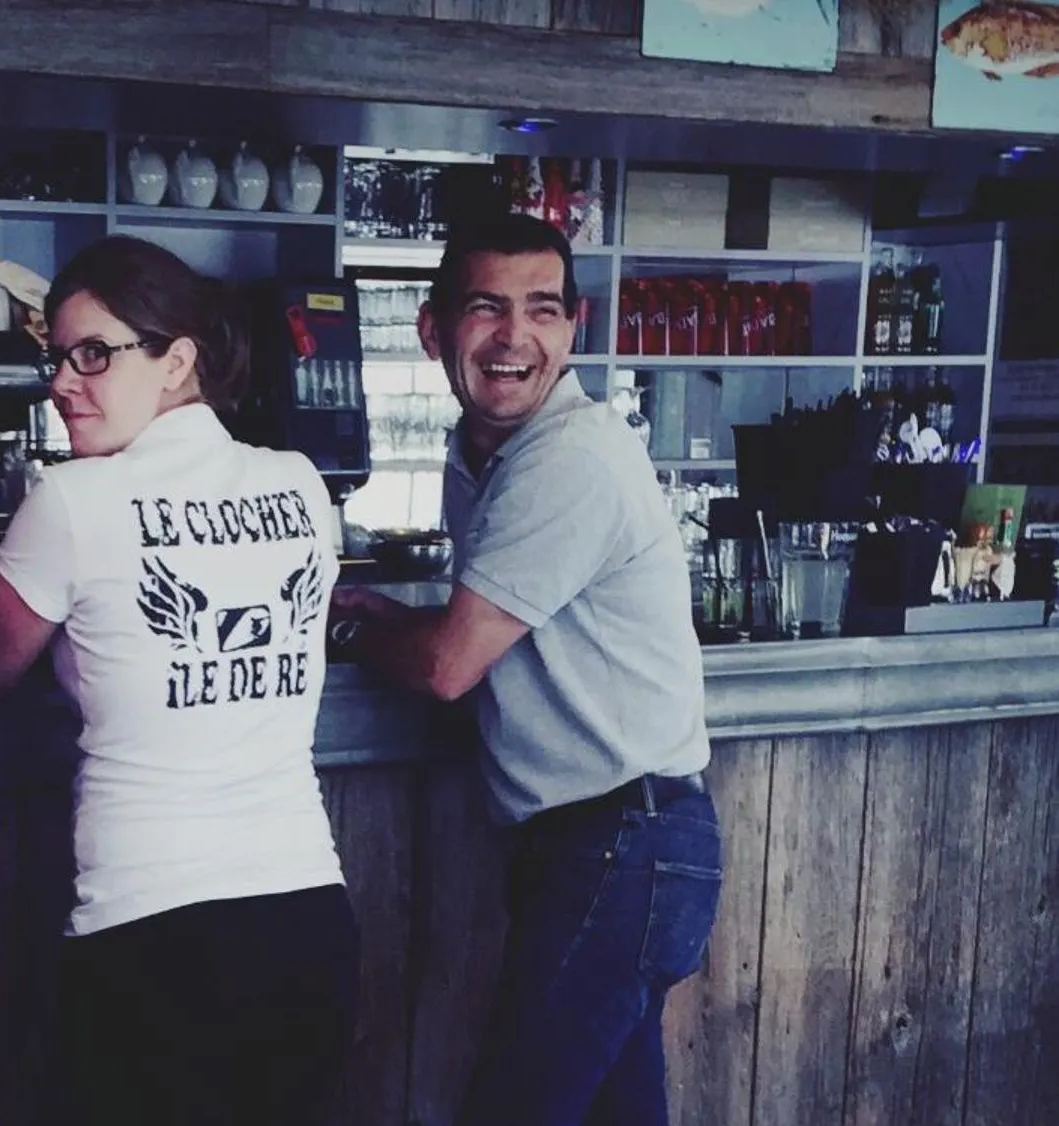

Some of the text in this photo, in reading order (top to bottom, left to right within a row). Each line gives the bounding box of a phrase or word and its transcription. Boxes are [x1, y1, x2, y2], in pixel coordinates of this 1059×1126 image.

[131, 490, 316, 547] LE CLOCHER
[227, 656, 267, 702] DE
